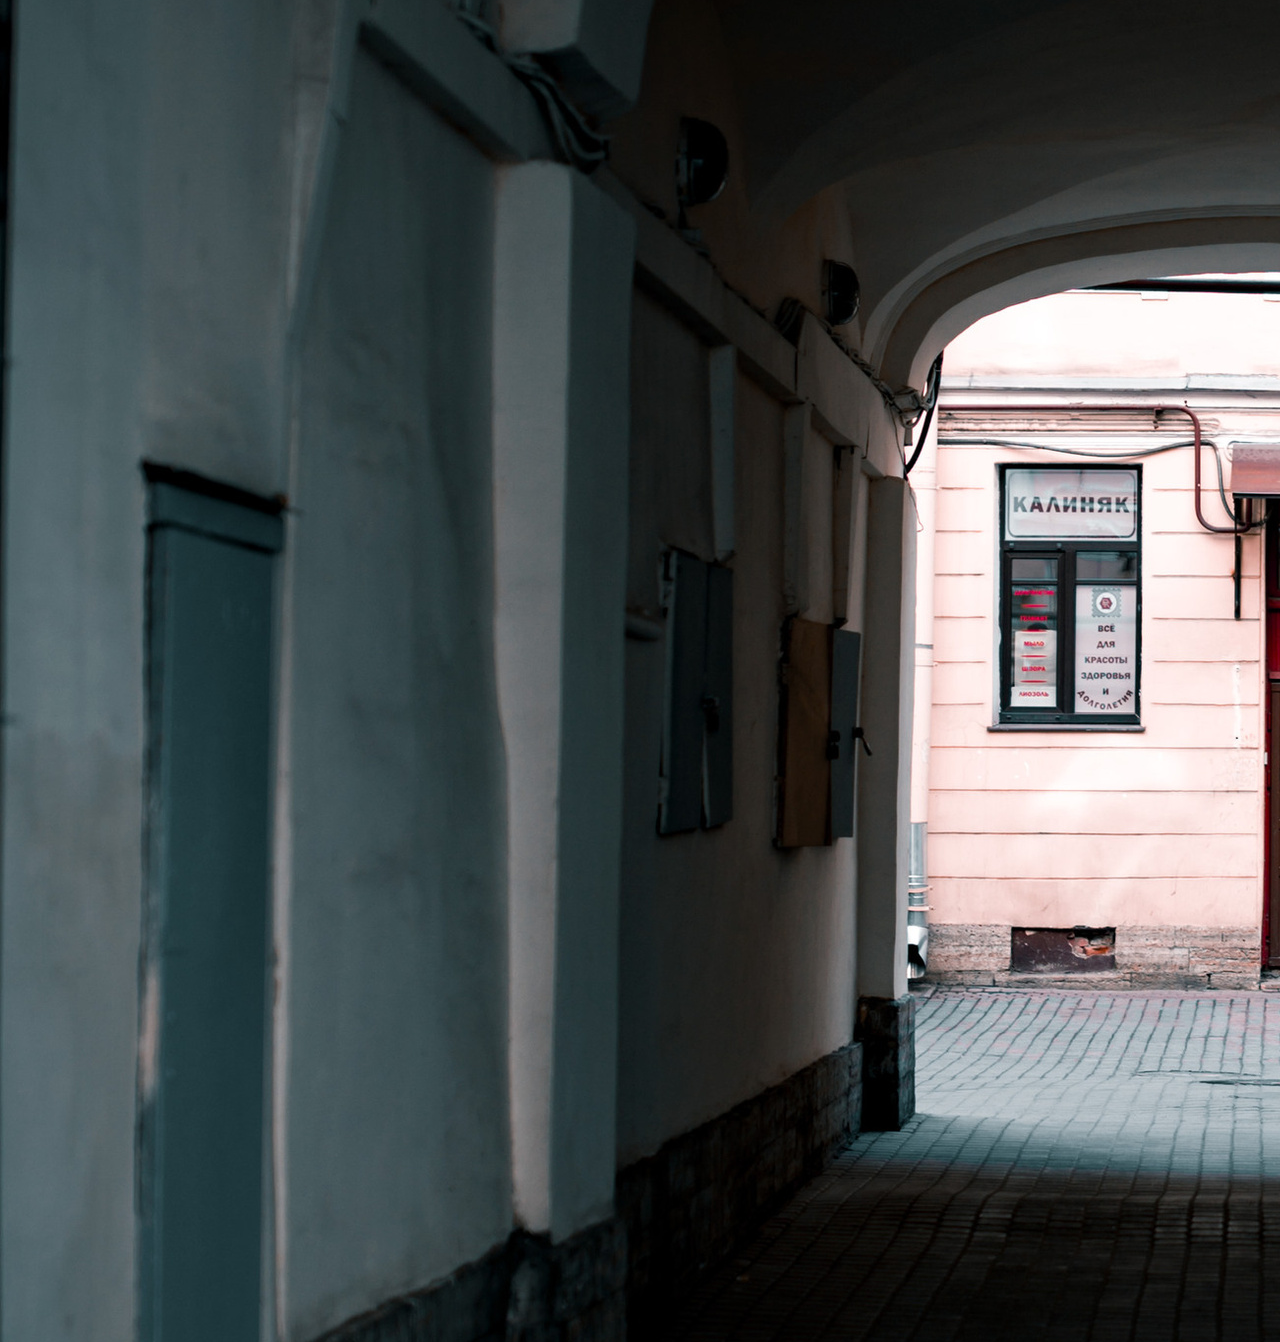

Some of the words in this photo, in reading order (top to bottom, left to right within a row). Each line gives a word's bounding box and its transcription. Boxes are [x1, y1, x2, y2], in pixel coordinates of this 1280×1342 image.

[1013, 496, 1130, 513] КАЛИНЯК
[1097, 623, 1116, 633] ВСЁ
[1096, 640, 1116, 649] ДЛЯ
[1084, 656, 1128, 664] КРАСОТЫ
[1081, 672, 1131, 680] ЗДОРОВЬЯ
[1102, 687, 1109, 695] И
[1077, 689, 1134, 710] ДОЛГОЛЕТИЯ
